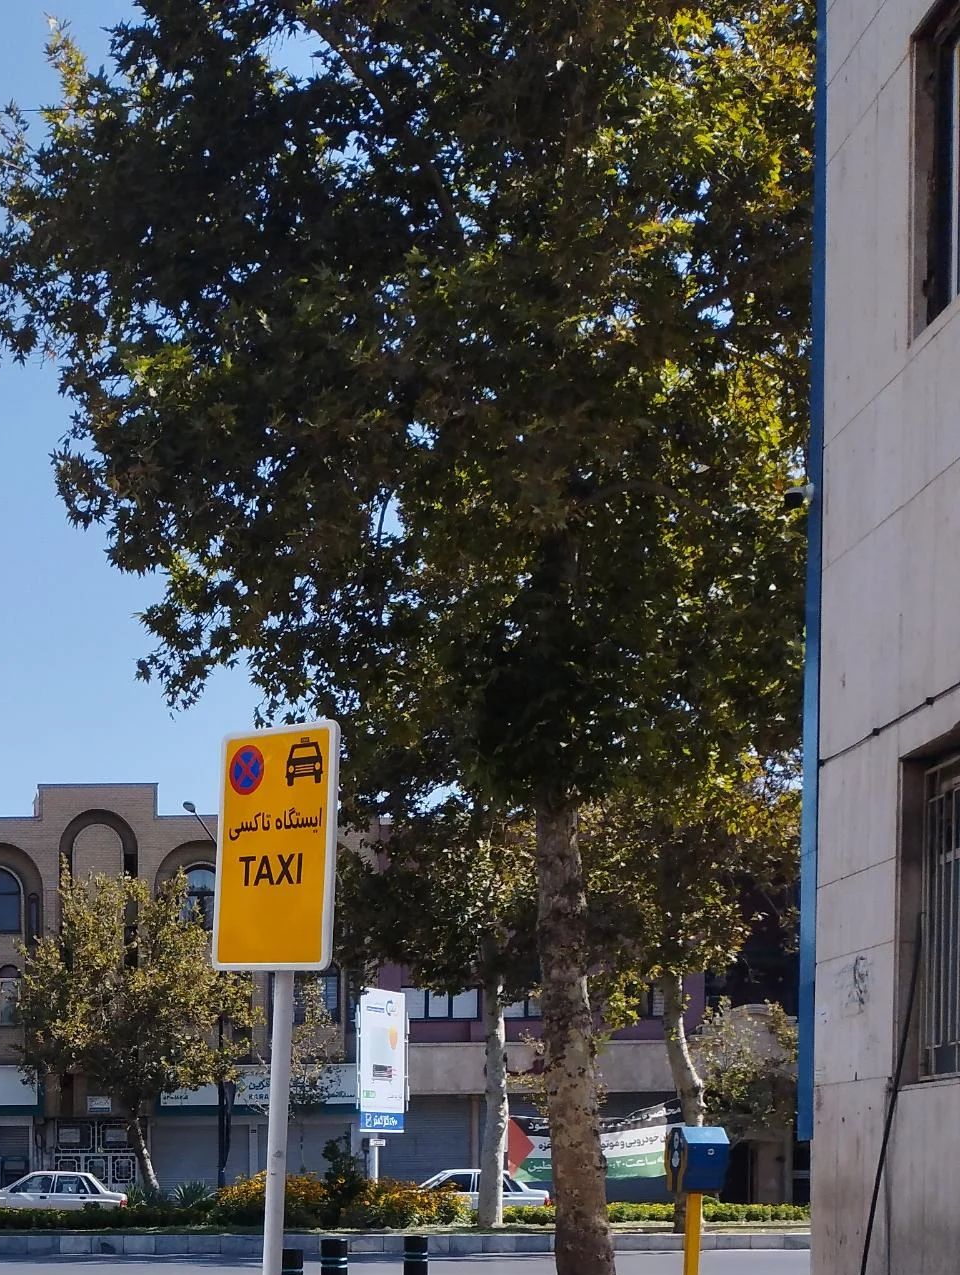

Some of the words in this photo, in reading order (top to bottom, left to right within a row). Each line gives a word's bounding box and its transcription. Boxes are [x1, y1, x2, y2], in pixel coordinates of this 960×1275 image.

[229, 812, 271, 841] تاکسی
[275, 807, 323, 834] ایستگاه
[238, 852, 303, 887] TAXI
